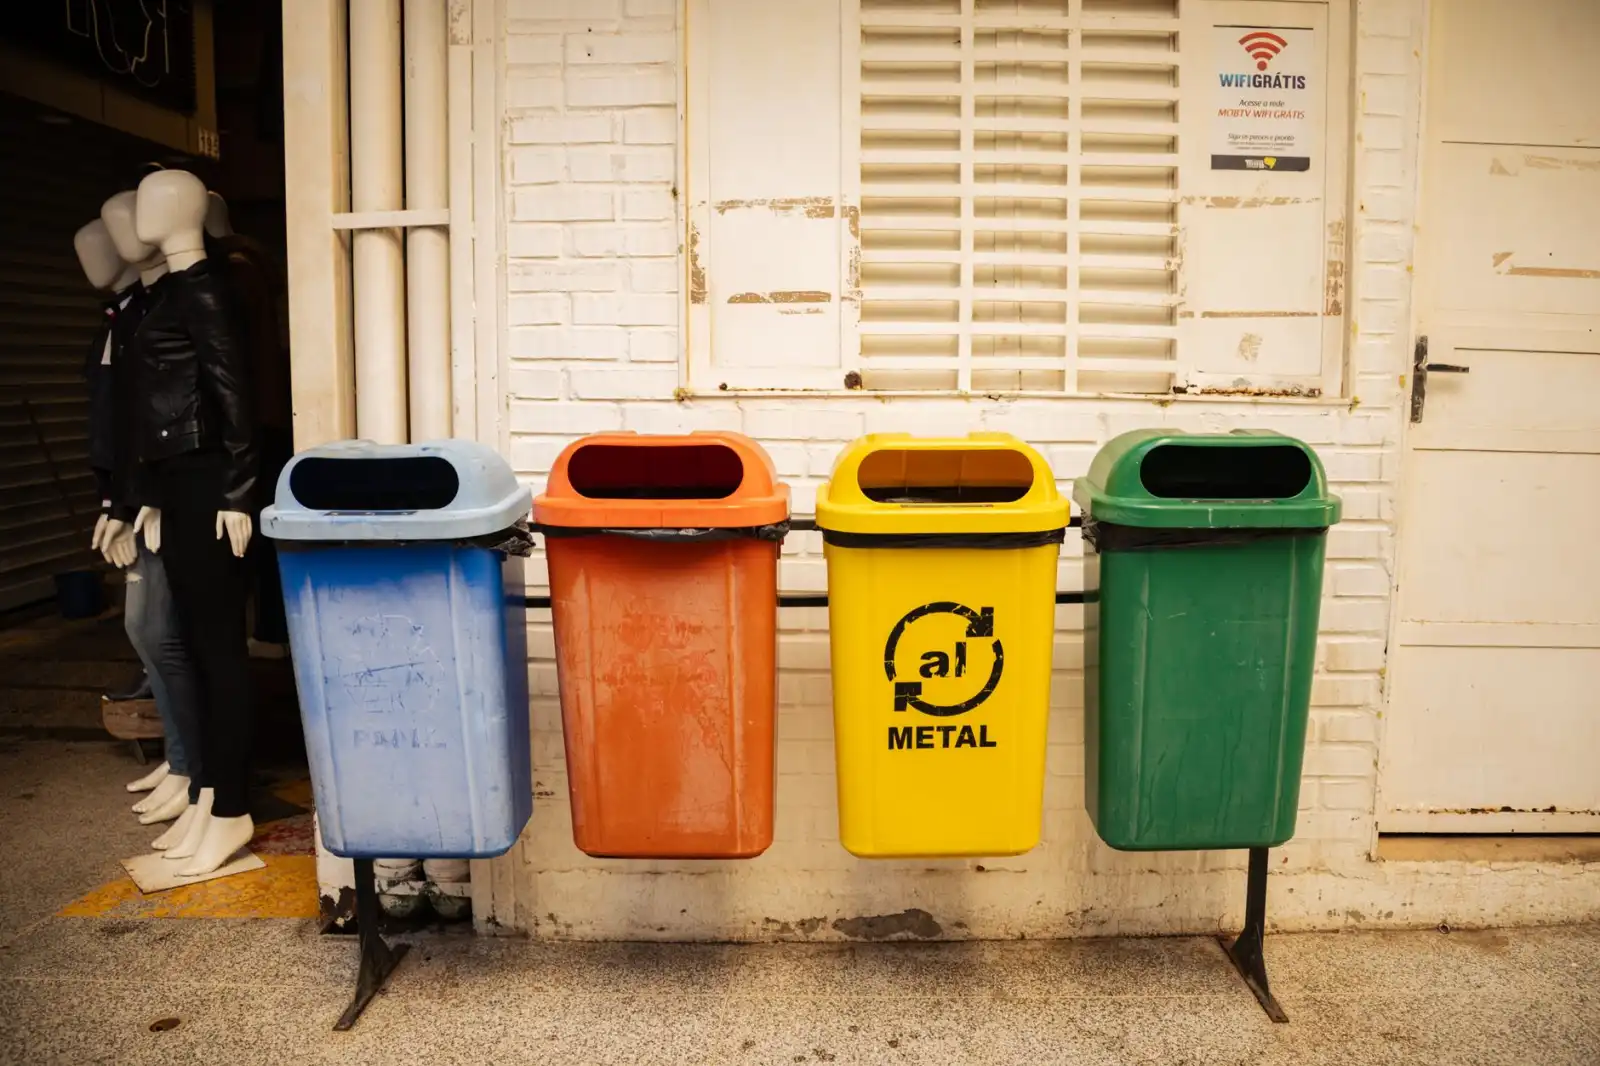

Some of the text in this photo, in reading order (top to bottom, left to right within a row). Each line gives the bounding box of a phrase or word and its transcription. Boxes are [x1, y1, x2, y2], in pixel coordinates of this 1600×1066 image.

[1218, 109, 1252, 117] MOBTV
[1253, 110, 1272, 118] WIFI
[887, 724, 997, 750] METAL
